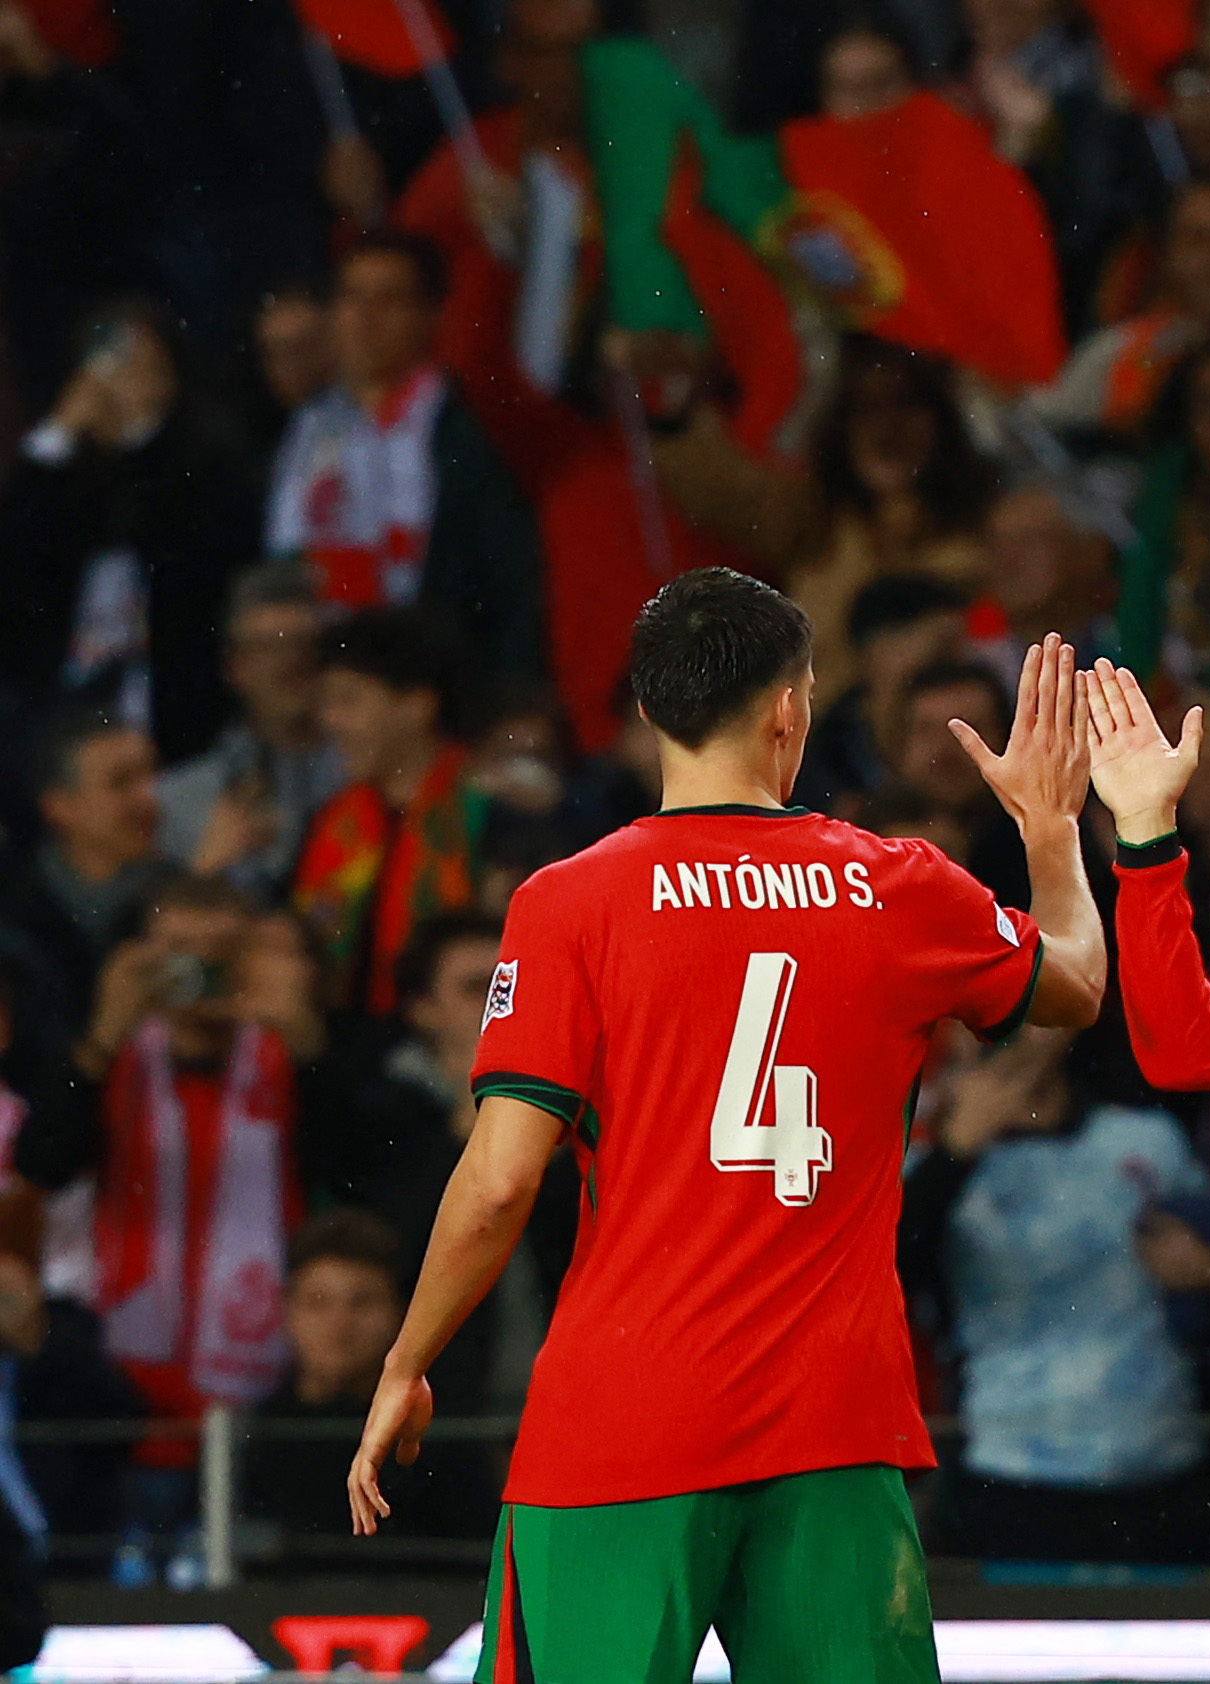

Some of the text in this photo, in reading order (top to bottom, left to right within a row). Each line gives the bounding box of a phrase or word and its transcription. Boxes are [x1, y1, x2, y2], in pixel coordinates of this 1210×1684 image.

[652, 854, 883, 911] ANTÓNIO S.
[710, 952, 832, 1206] 4
